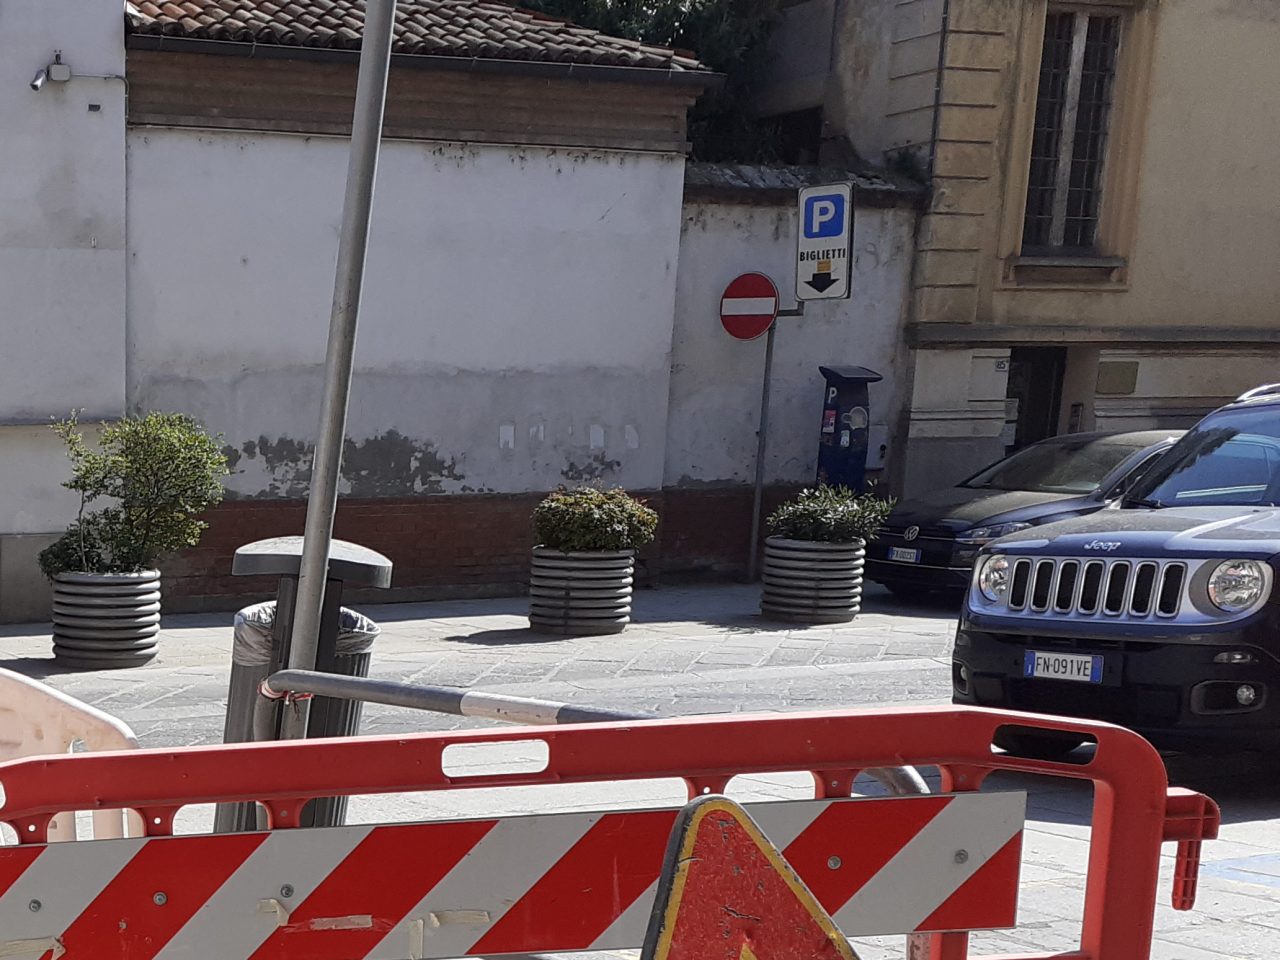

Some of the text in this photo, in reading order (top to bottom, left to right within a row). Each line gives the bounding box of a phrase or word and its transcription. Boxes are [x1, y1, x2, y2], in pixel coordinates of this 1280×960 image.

[812, 200, 836, 233] P
[800, 248, 846, 261] BIGLIETTI
[827, 386, 838, 404] P
[1083, 539, 1122, 552] Jeep
